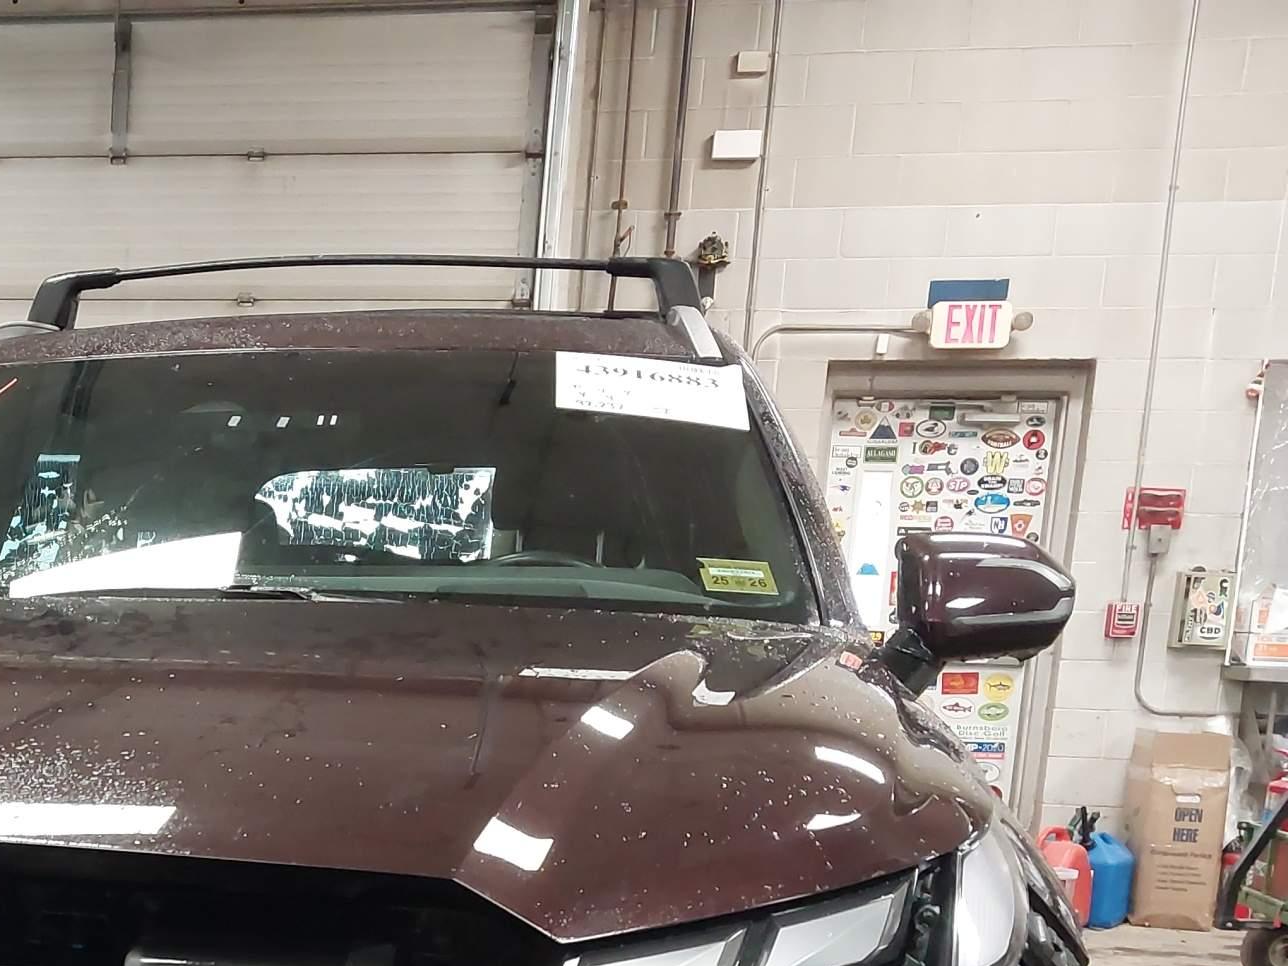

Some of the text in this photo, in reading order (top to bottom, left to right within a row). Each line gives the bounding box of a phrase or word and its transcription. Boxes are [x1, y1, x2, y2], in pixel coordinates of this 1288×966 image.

[944, 304, 1002, 345] EXIT
[575, 364, 720, 389] 43916883
[948, 479, 968, 491] STP
[711, 575, 768, 588] 25 26
[1174, 807, 1204, 823] OPEN
[1172, 827, 1200, 843] HERE
